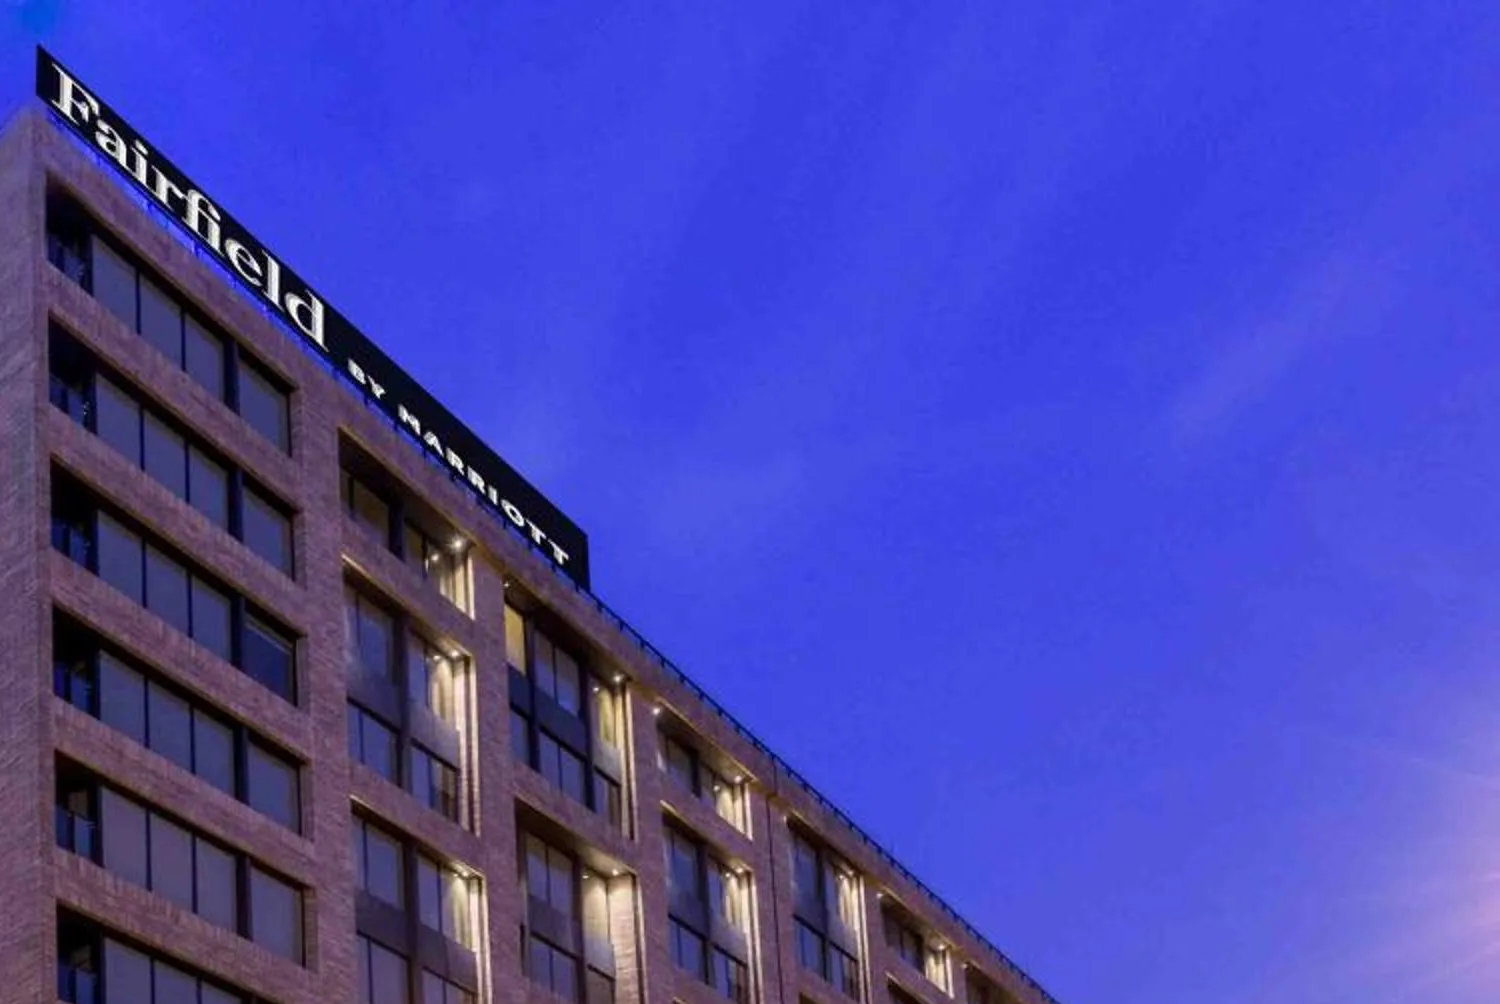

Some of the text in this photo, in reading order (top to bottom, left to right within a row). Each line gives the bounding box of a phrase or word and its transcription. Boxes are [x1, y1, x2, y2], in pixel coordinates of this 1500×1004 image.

[51, 62, 569, 566] Fairfield BY MARRIOTT
